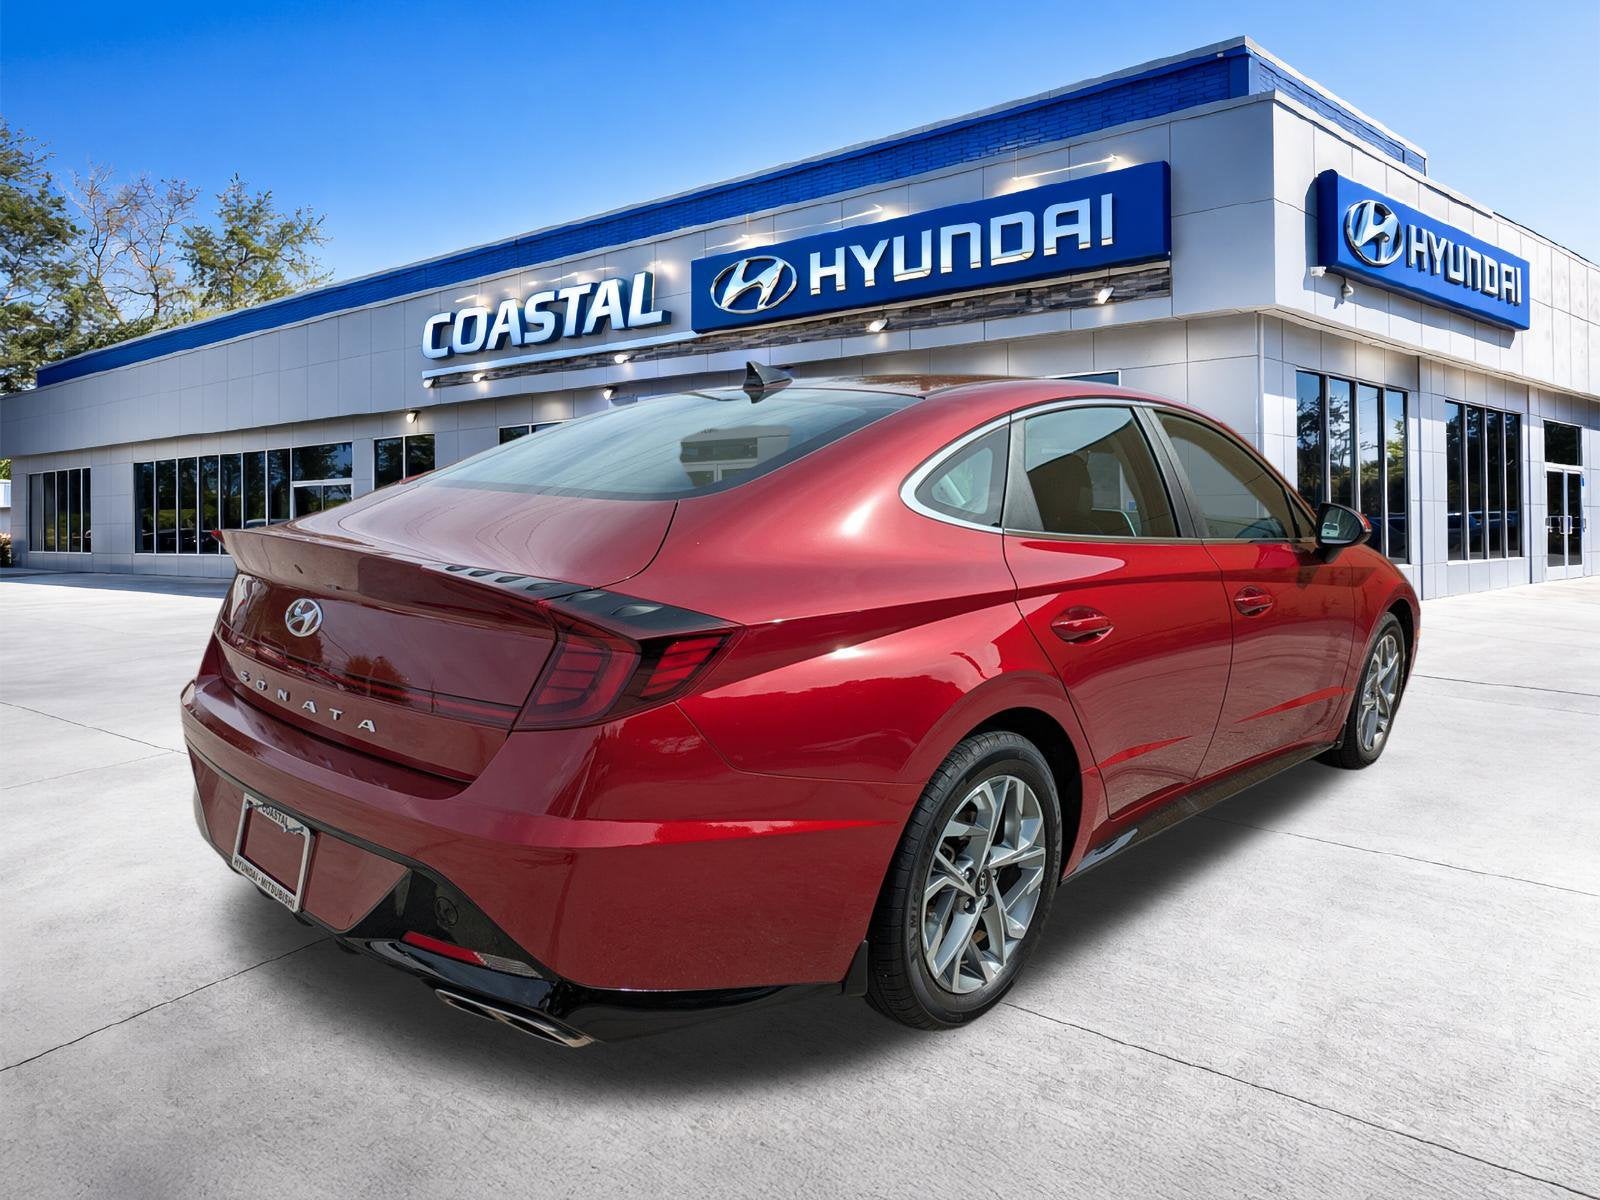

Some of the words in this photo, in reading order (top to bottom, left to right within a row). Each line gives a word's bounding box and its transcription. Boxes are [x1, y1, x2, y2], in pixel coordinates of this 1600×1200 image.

[810, 193, 1113, 296] HYUNDAI
[1406, 224, 1522, 306] HYUNDAI
[422, 271, 671, 359] COASTAL
[240, 671, 376, 733] SONATA
[261, 804, 289, 830] COASTAL
